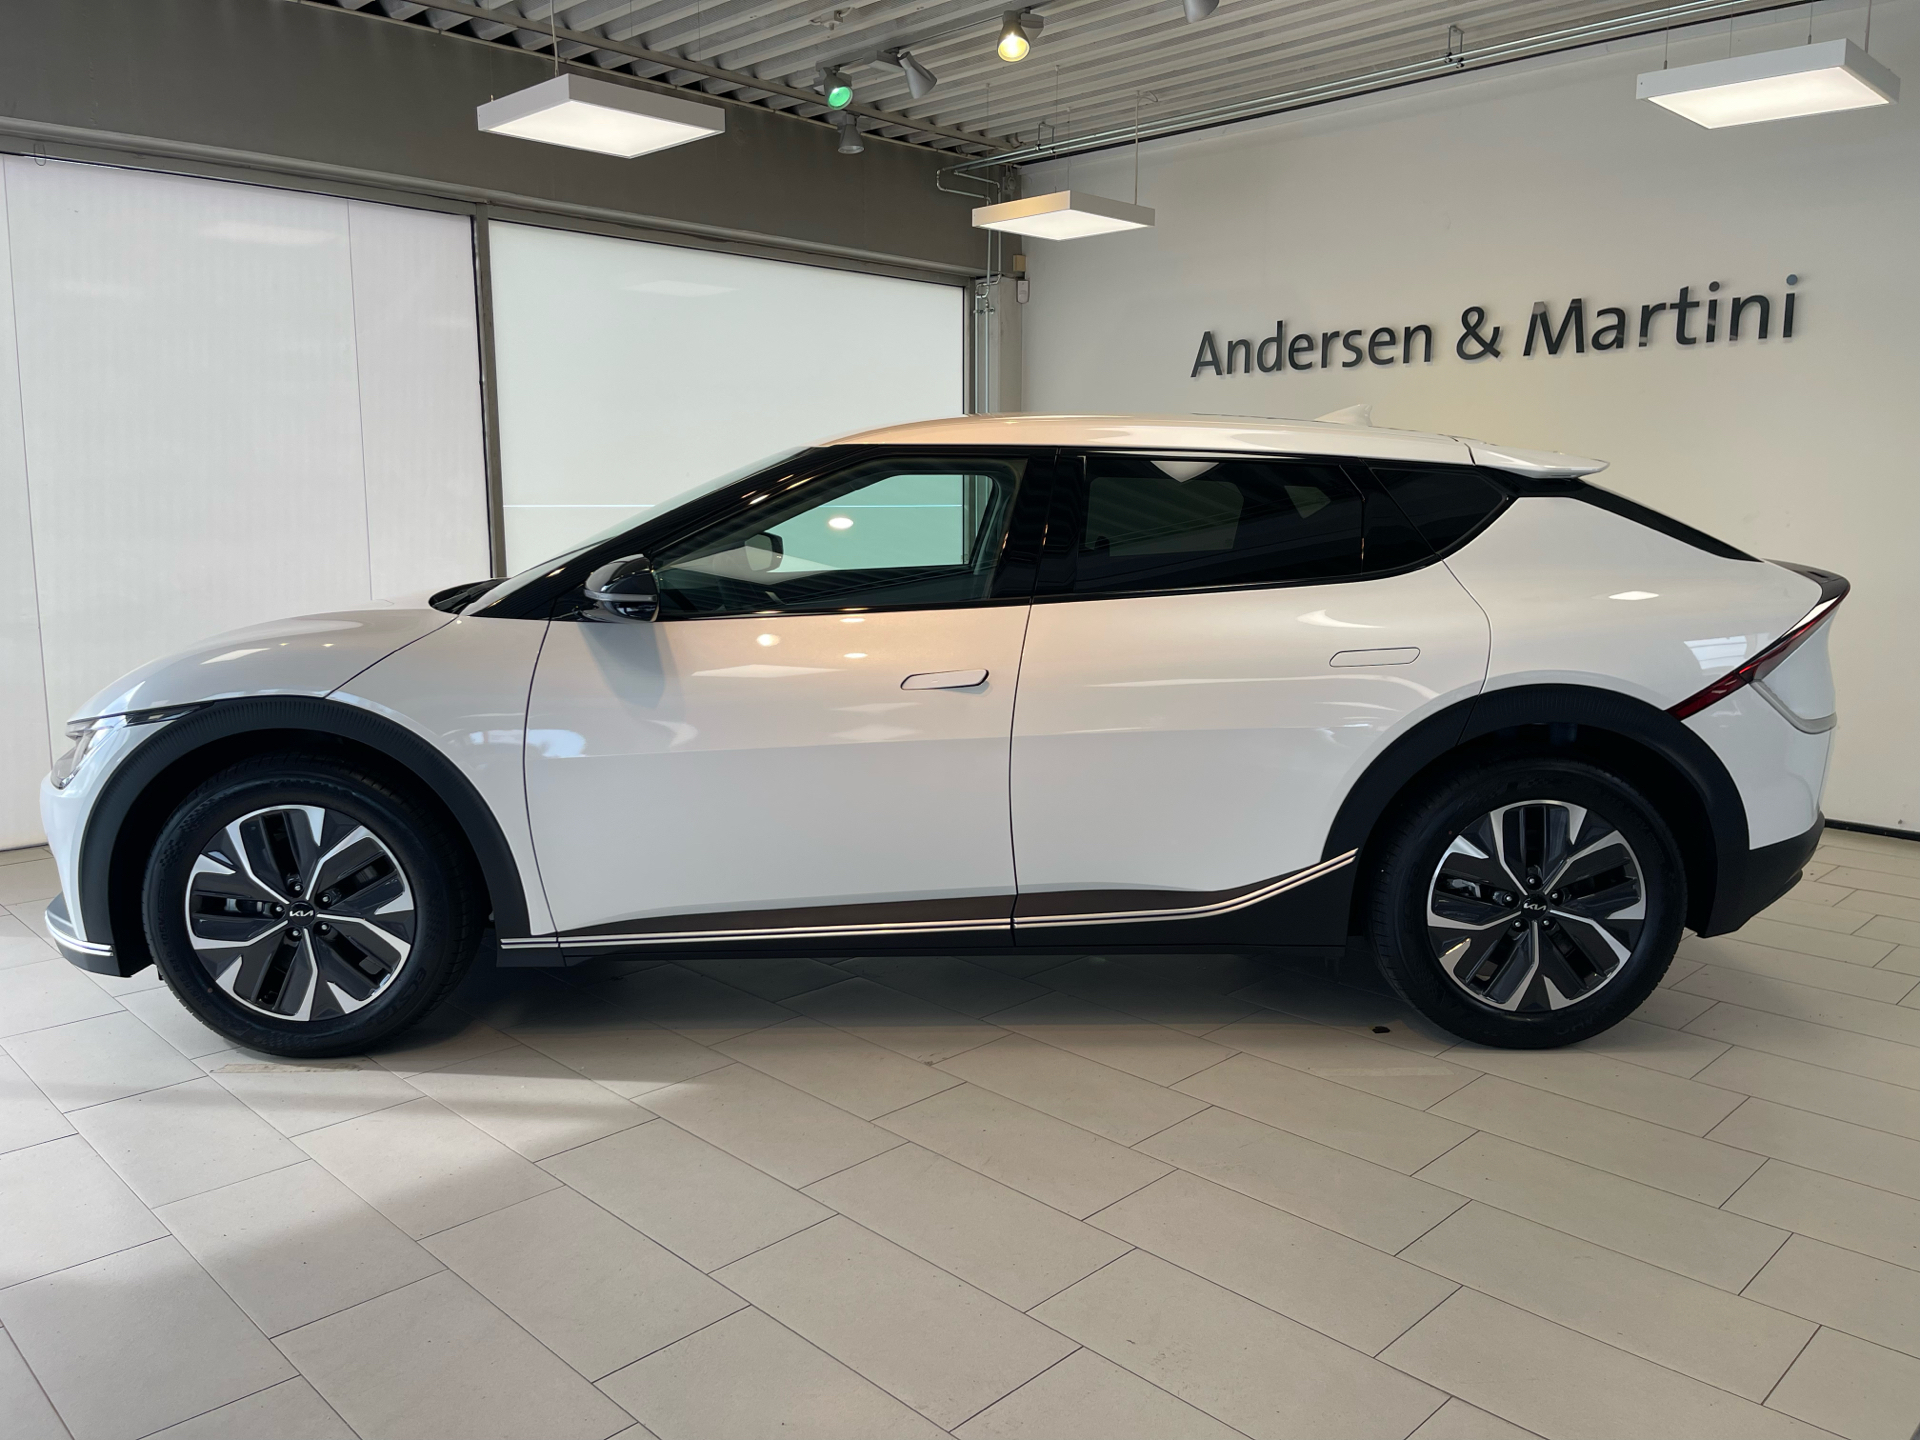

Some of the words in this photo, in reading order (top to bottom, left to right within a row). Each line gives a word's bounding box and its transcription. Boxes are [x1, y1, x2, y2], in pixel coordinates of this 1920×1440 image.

[1190, 320, 1433, 378] Andersen
[1455, 305, 1501, 360] &
[1522, 273, 1799, 357] Martini
[1523, 902, 1547, 911] KIA
